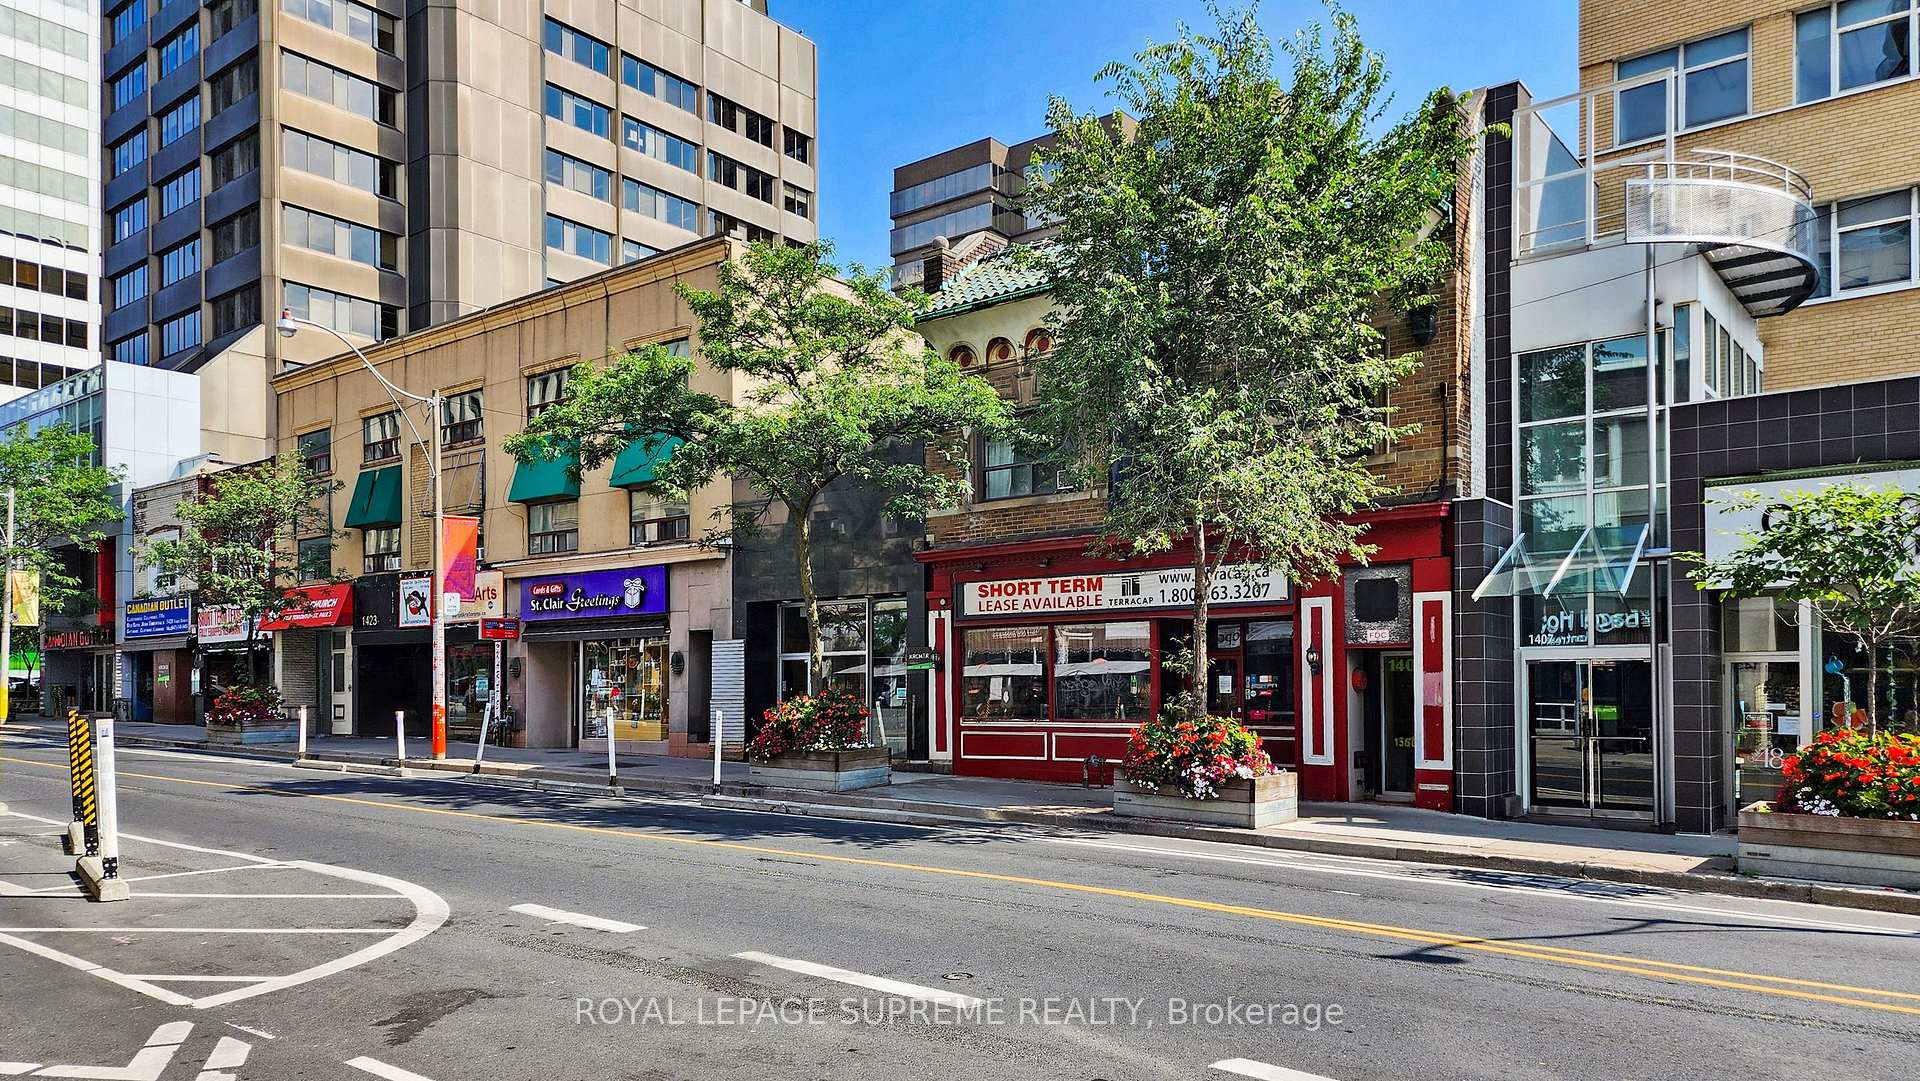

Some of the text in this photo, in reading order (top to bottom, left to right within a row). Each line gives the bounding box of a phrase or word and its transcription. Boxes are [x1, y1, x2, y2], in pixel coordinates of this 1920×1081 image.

[475, 586, 498, 601] Arts
[532, 585, 546, 594] Cards
[550, 584, 562, 594] Gifts
[978, 577, 1103, 598] SHORT TERM
[127, 598, 188, 614] CANADIAN OUTLET
[310, 598, 338, 609] CHURCH
[531, 588, 620, 612] St. Clair Greetings
[978, 595, 1103, 612] LEASE AVAILABLE
[1108, 597, 1154, 607] TERRACAP
[362, 614, 378, 626] 1423
[1369, 631, 1387, 639] FDC
[1528, 634, 1554, 645] 1407
